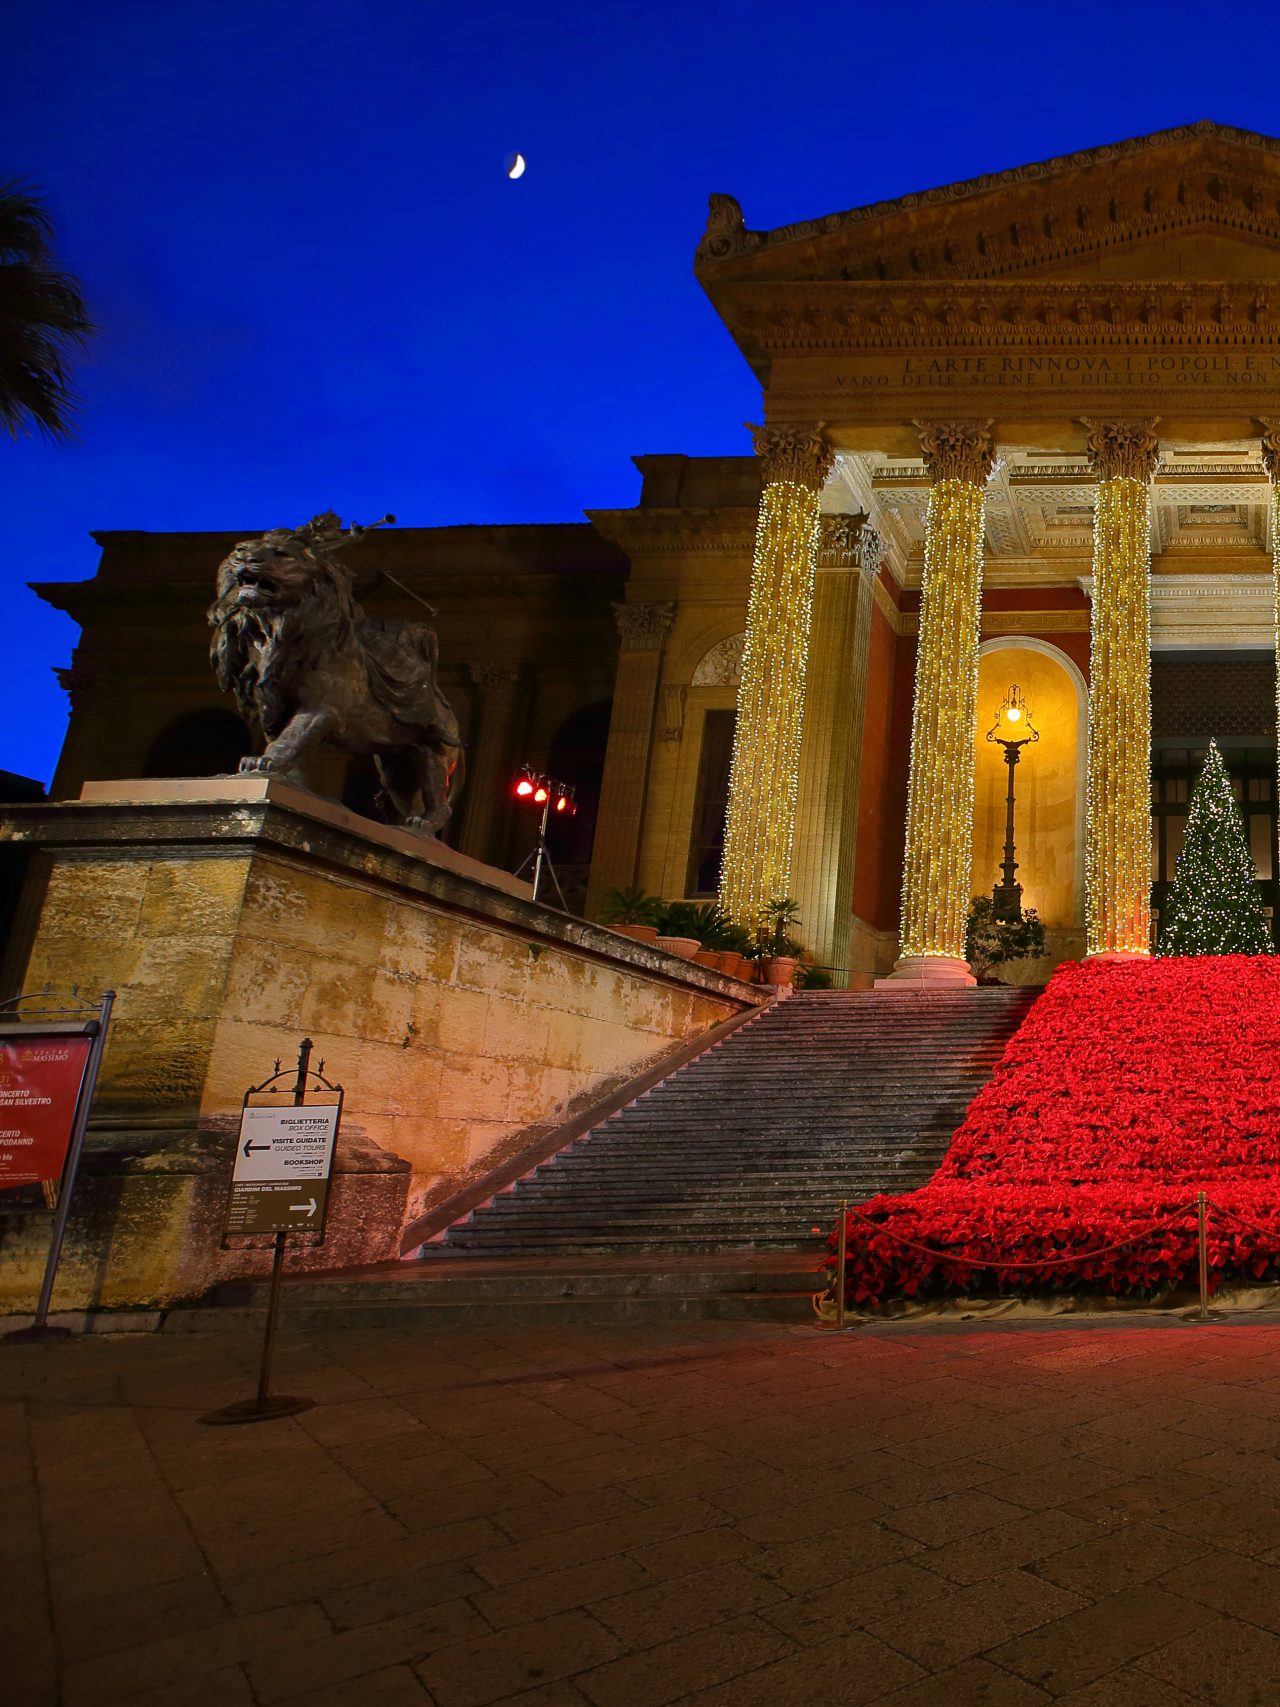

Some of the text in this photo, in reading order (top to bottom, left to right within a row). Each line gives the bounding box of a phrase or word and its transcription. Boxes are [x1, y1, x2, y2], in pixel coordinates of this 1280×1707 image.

[1002, 357, 1112, 372] RINNOVA
[1147, 357, 1230, 371] POPOLI
[1244, 357, 1257, 371] E
[836, 375, 889, 386] VANO
[902, 374, 955, 386] DELLE
[971, 373, 1035, 385] SCENE
[1050, 373, 1065, 384] IL
[1082, 372, 1160, 384] DILETTO
[1176, 372, 1211, 384] OVE
[1226, 372, 1267, 384] NON
[32, 1054, 69, 1062] MASSIMO
